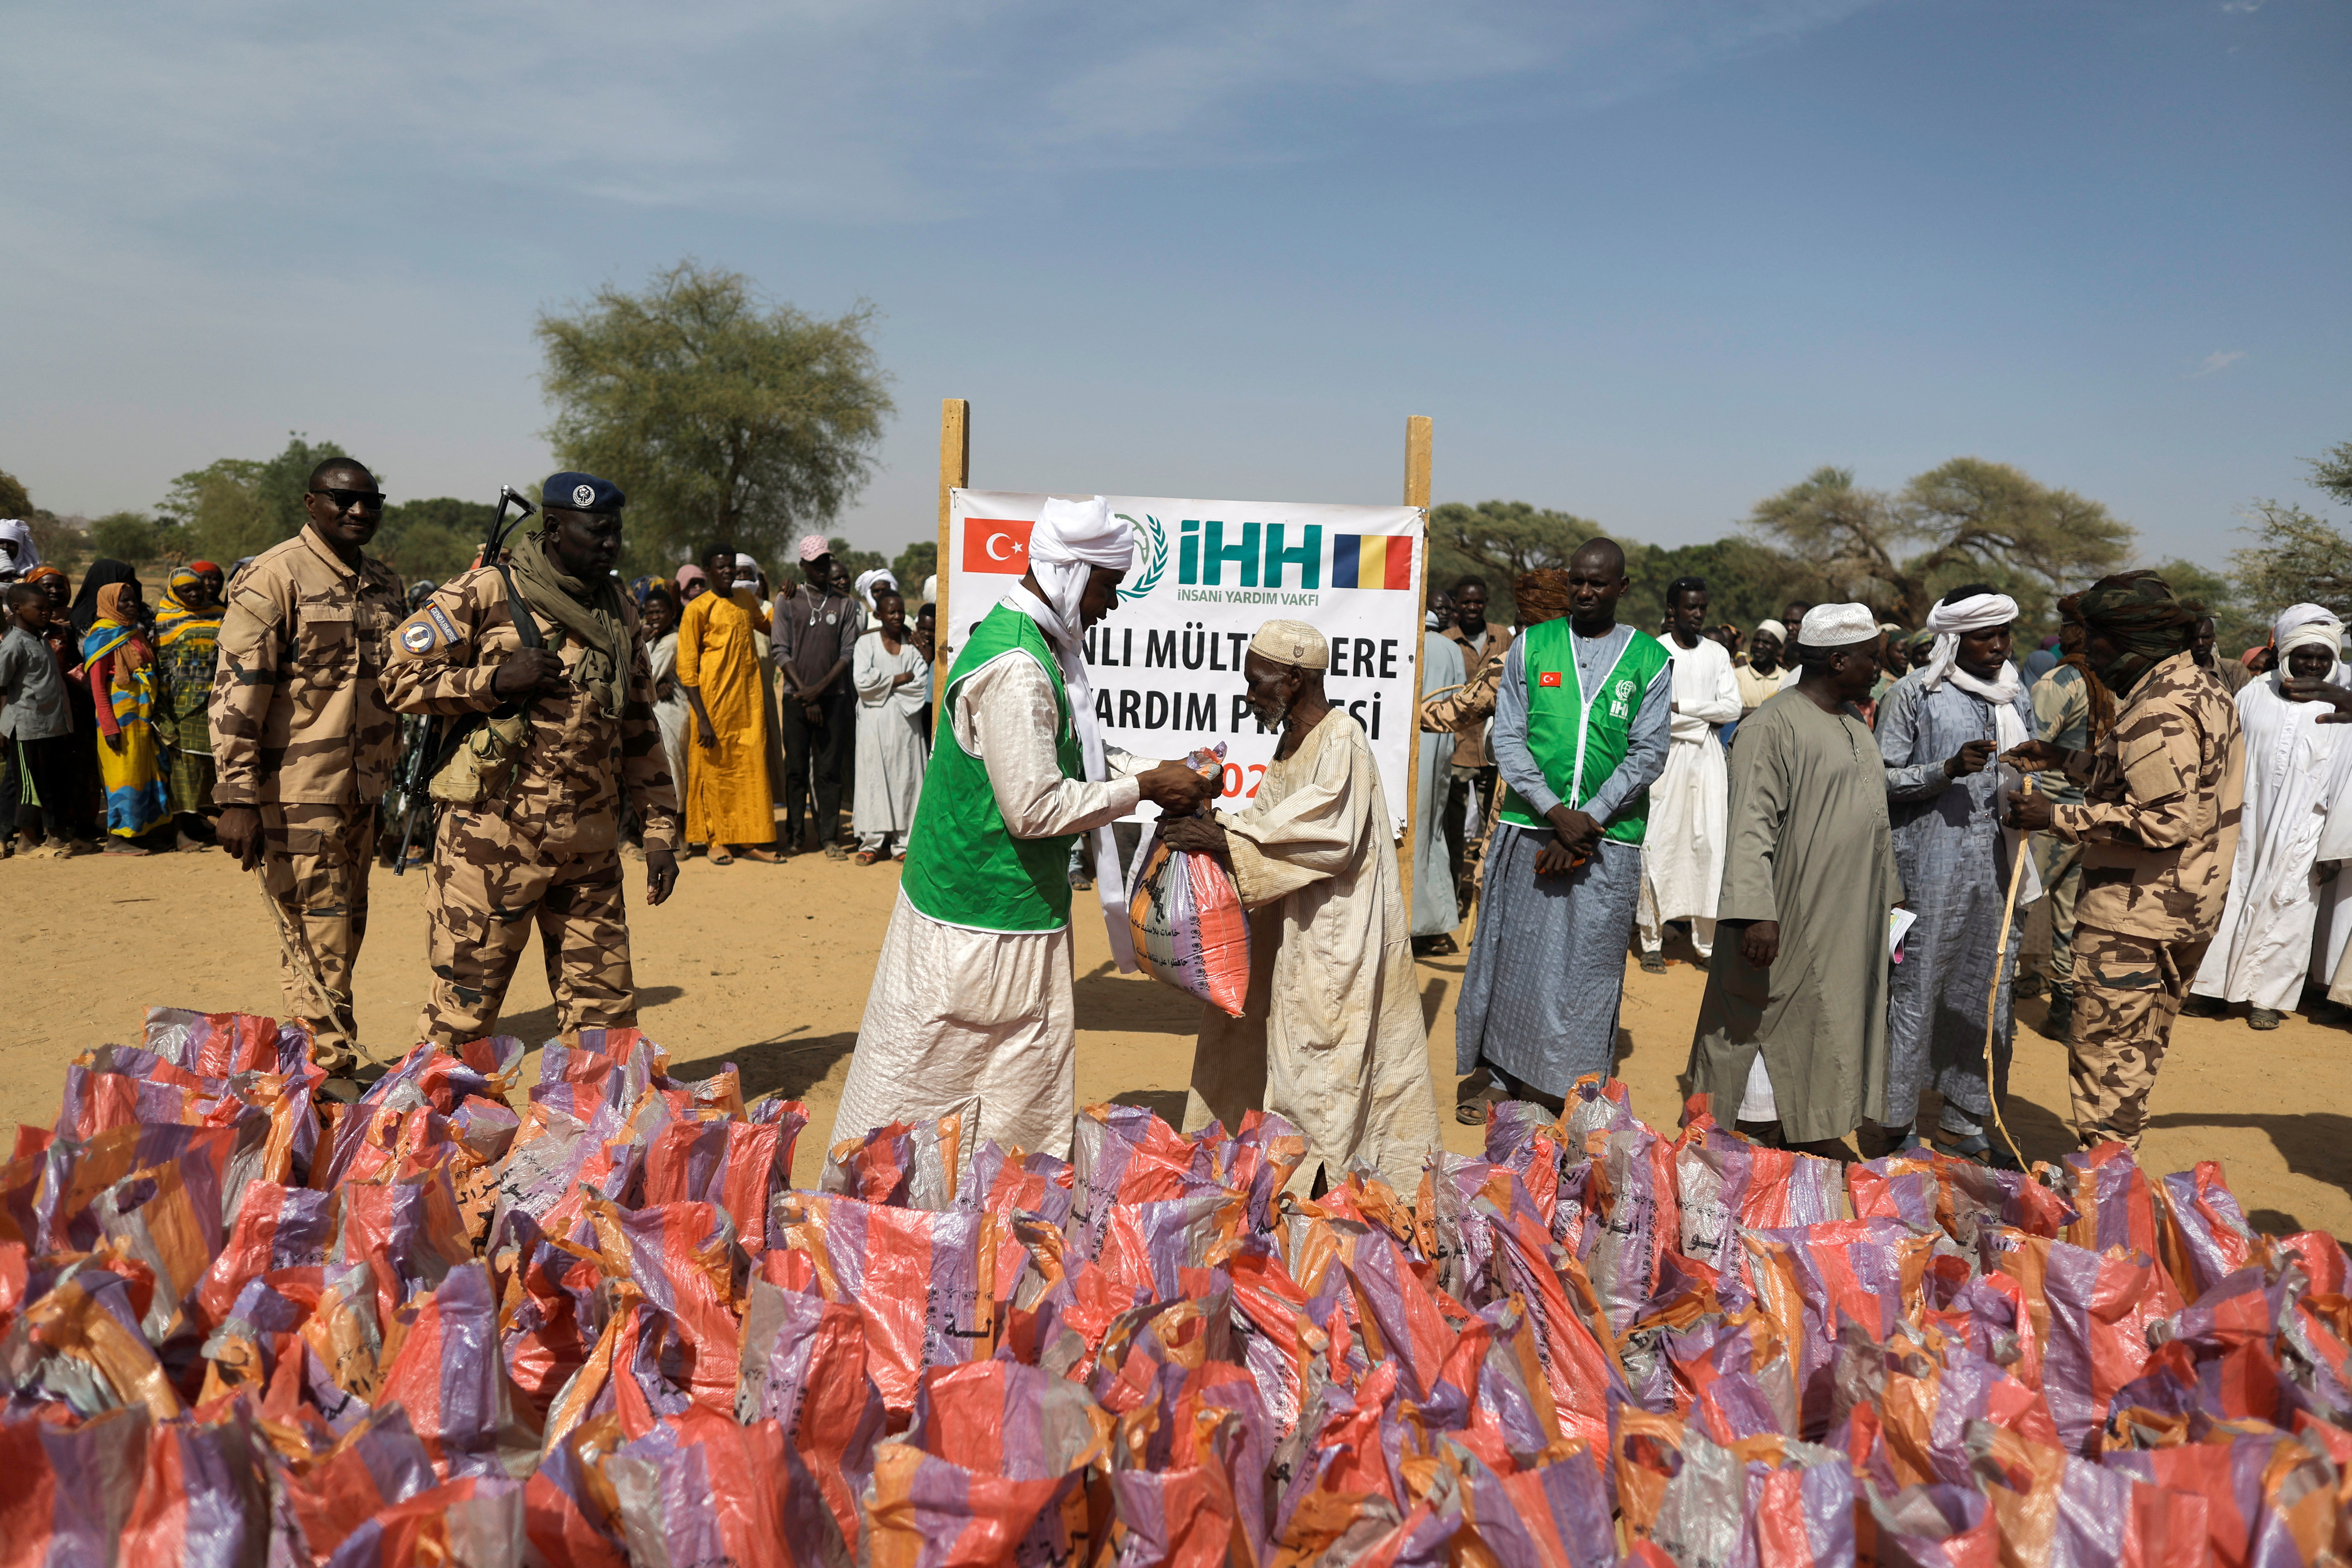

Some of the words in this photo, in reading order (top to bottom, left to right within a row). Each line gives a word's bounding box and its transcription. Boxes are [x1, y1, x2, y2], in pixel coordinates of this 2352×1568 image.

[1225, 591, 1277, 605] YARDIM
[1281, 593, 1319, 606] VAKFI
[431, 608, 456, 642] GENDARMERIE
[1145, 621, 1398, 679] MÜLTERE
[1090, 688, 1217, 732] ARDIM
[1161, 929, 1180, 937] خامات
[1159, 957, 1167, 966] على
[1167, 957, 1188, 968] حافظوا
